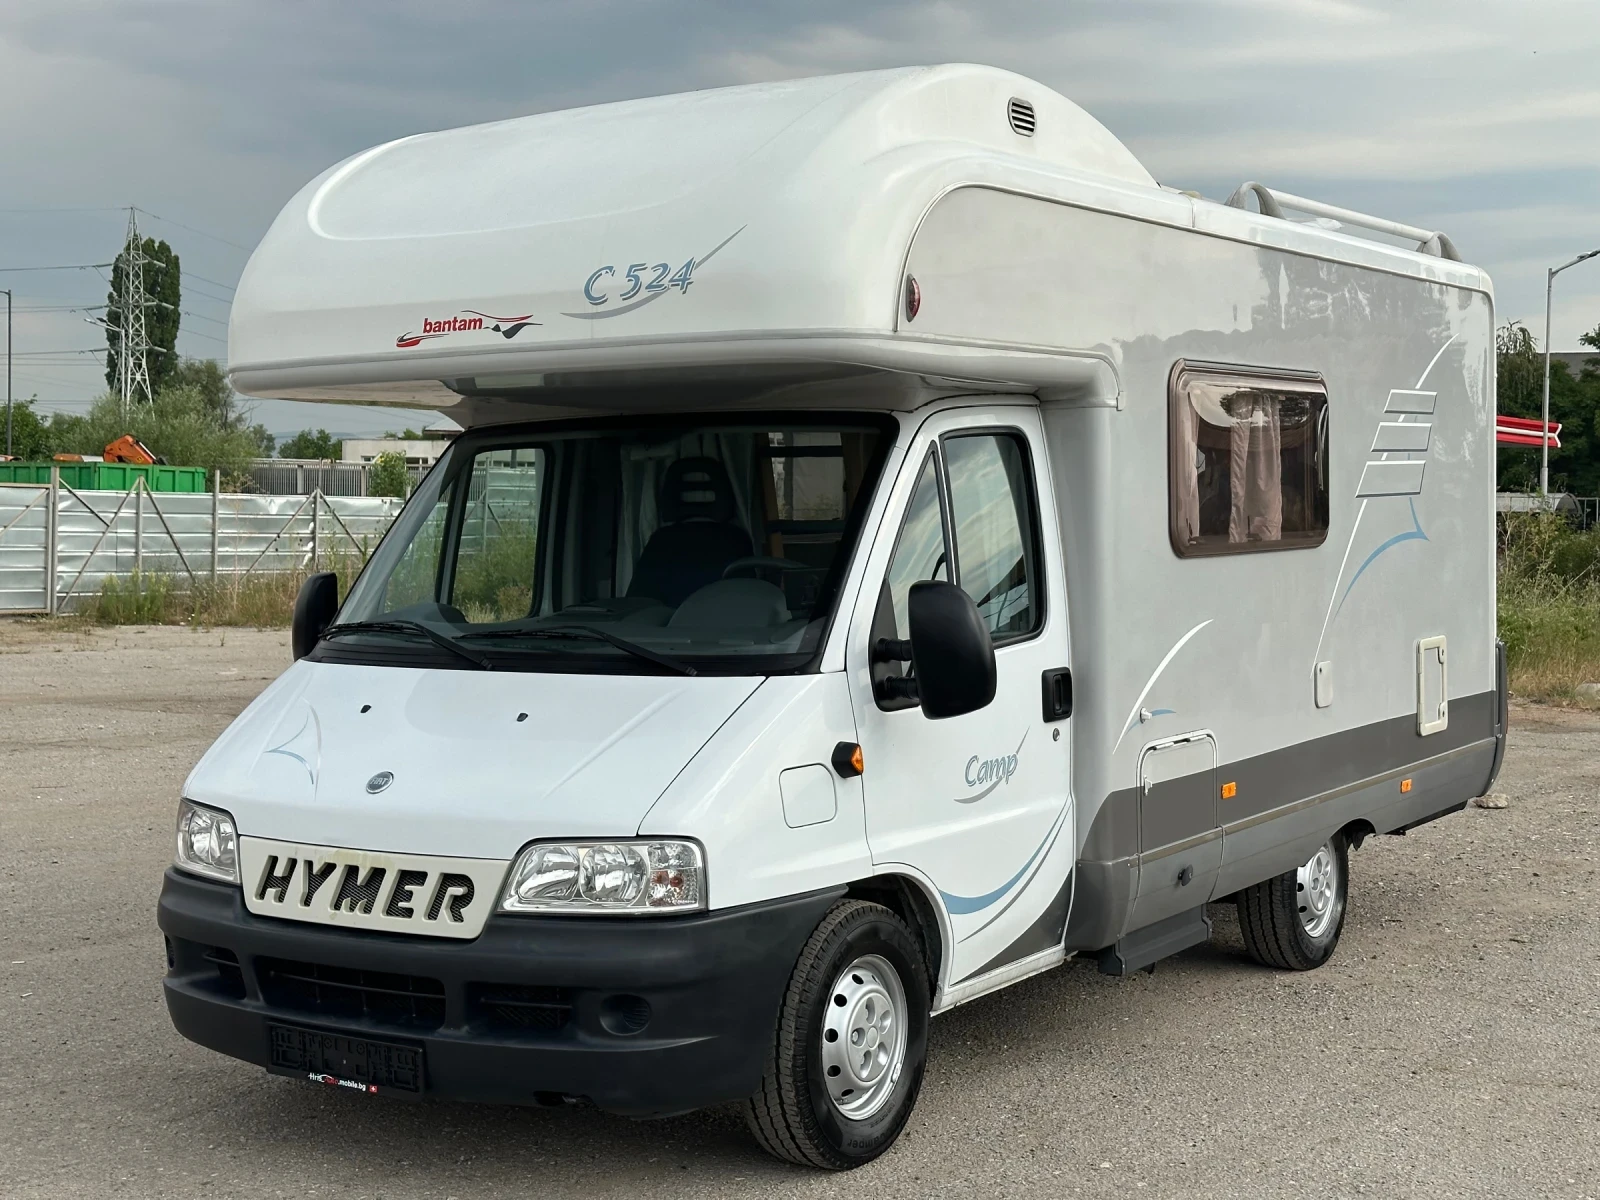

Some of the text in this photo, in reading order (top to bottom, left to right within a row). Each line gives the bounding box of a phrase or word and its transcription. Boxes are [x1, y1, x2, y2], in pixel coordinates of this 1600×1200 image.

[584, 257, 695, 306] C 524
[423, 317, 483, 334] bantam
[965, 753, 1019, 787] Camp
[254, 855, 475, 923] HYMER
